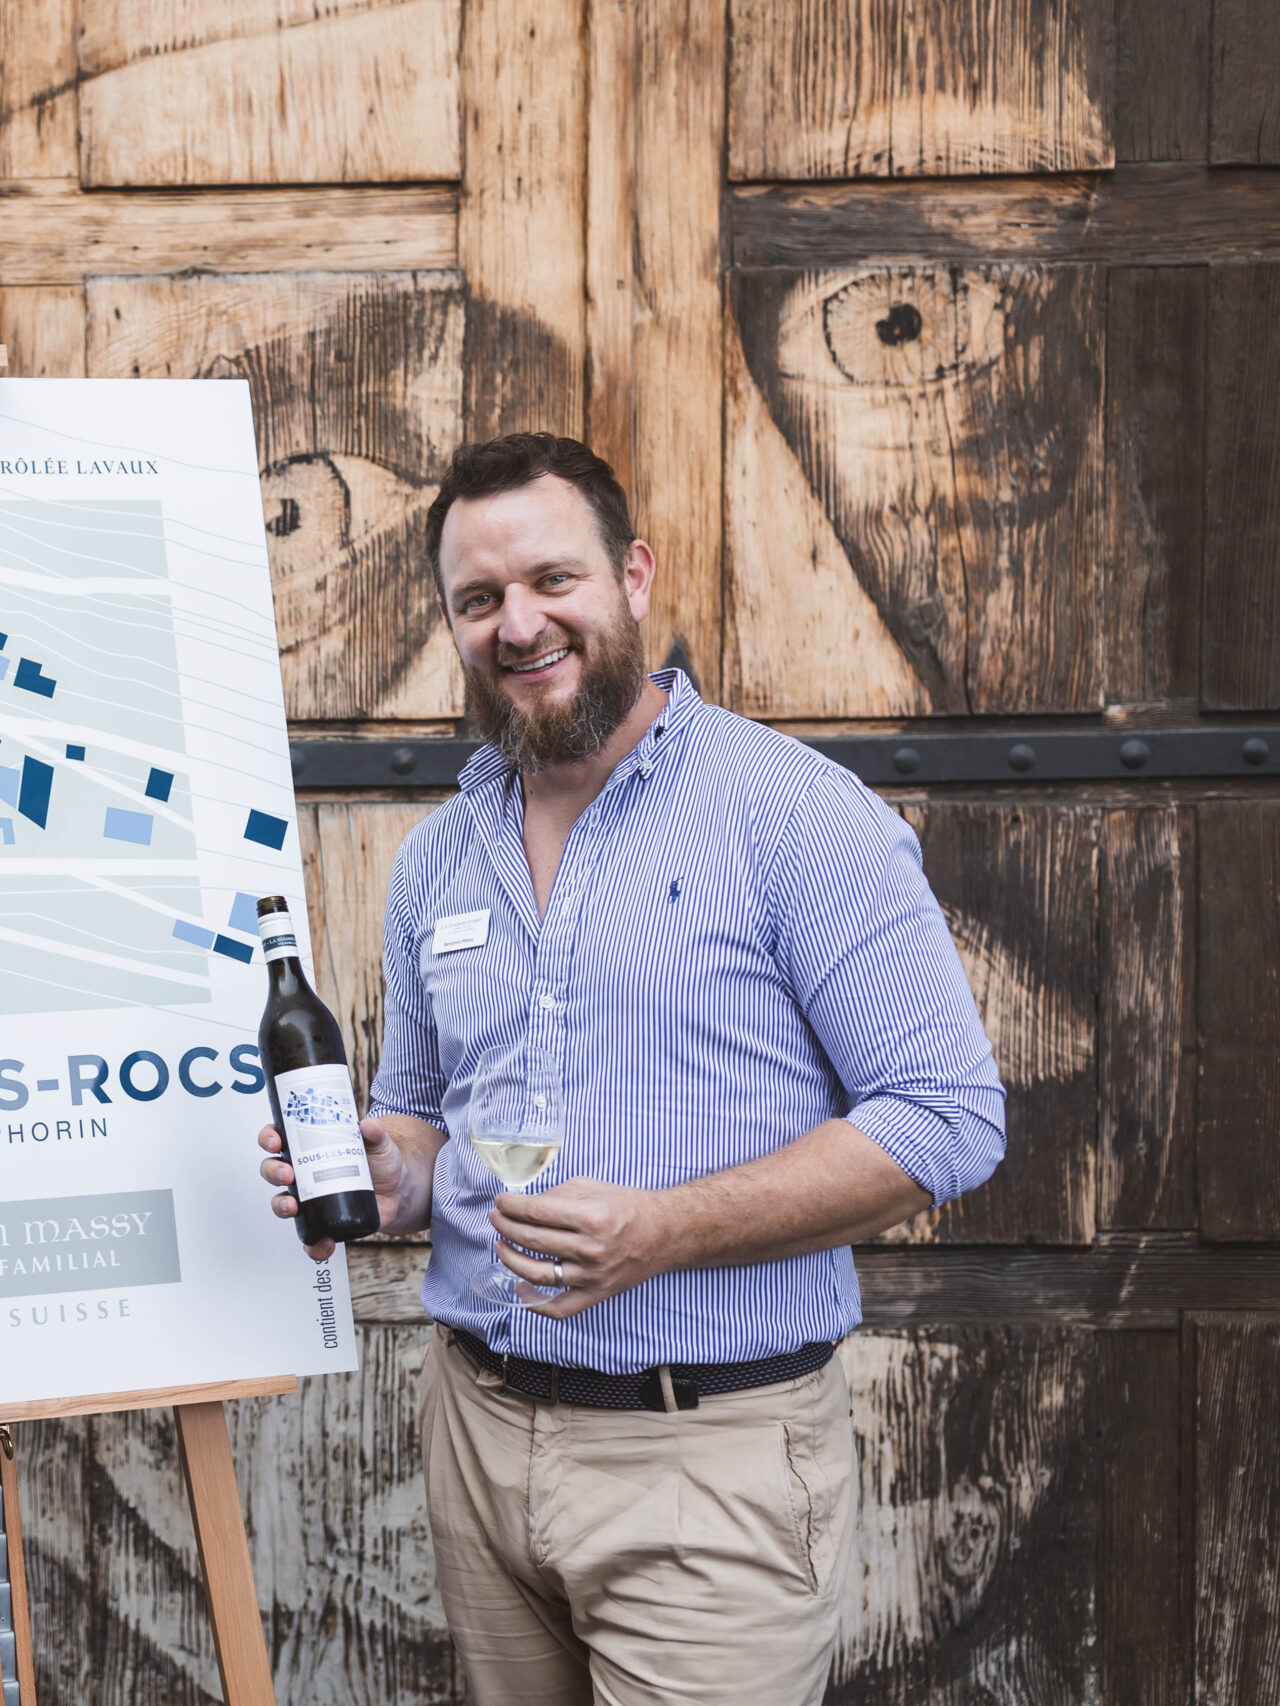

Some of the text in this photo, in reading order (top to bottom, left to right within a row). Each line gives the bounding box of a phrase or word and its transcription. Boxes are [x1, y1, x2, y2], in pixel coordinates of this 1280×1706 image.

[75, 460, 159, 475] LAVAUX
[23, 1211, 153, 1246] MASSY
[312, 1269, 333, 1293] des
[315, 1296, 339, 1349] contient
